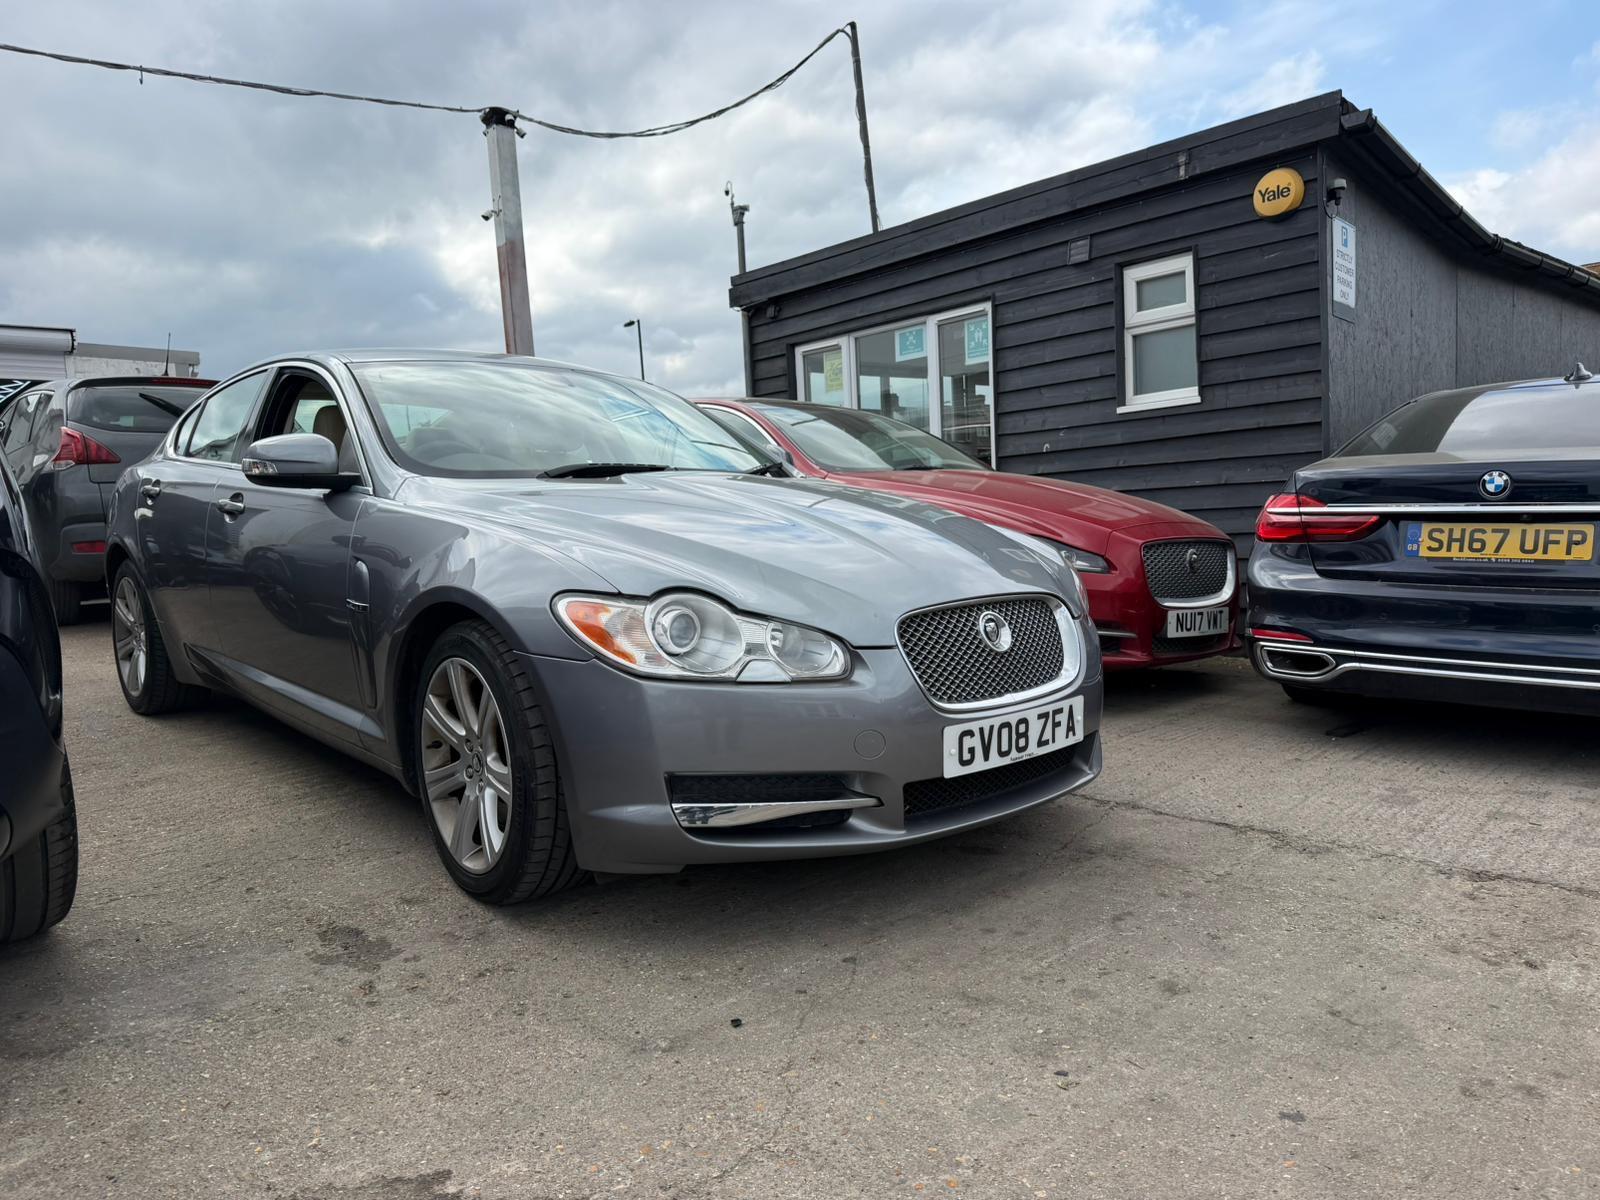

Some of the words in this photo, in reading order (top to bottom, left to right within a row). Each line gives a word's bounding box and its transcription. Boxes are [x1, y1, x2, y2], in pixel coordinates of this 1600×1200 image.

[1258, 184, 1291, 203] Yale
[1336, 248, 1353, 264] STRICTLY
[1335, 261, 1354, 277] CUSTOMER
[1336, 274, 1353, 290] PARKING
[1407, 543, 1418, 551] GB
[1426, 527, 1511, 553] SH67
[1519, 528, 1588, 556] UFP
[1176, 611, 1204, 633] NU17
[958, 717, 1029, 767] GV08
[1037, 704, 1076, 748] ZFA
